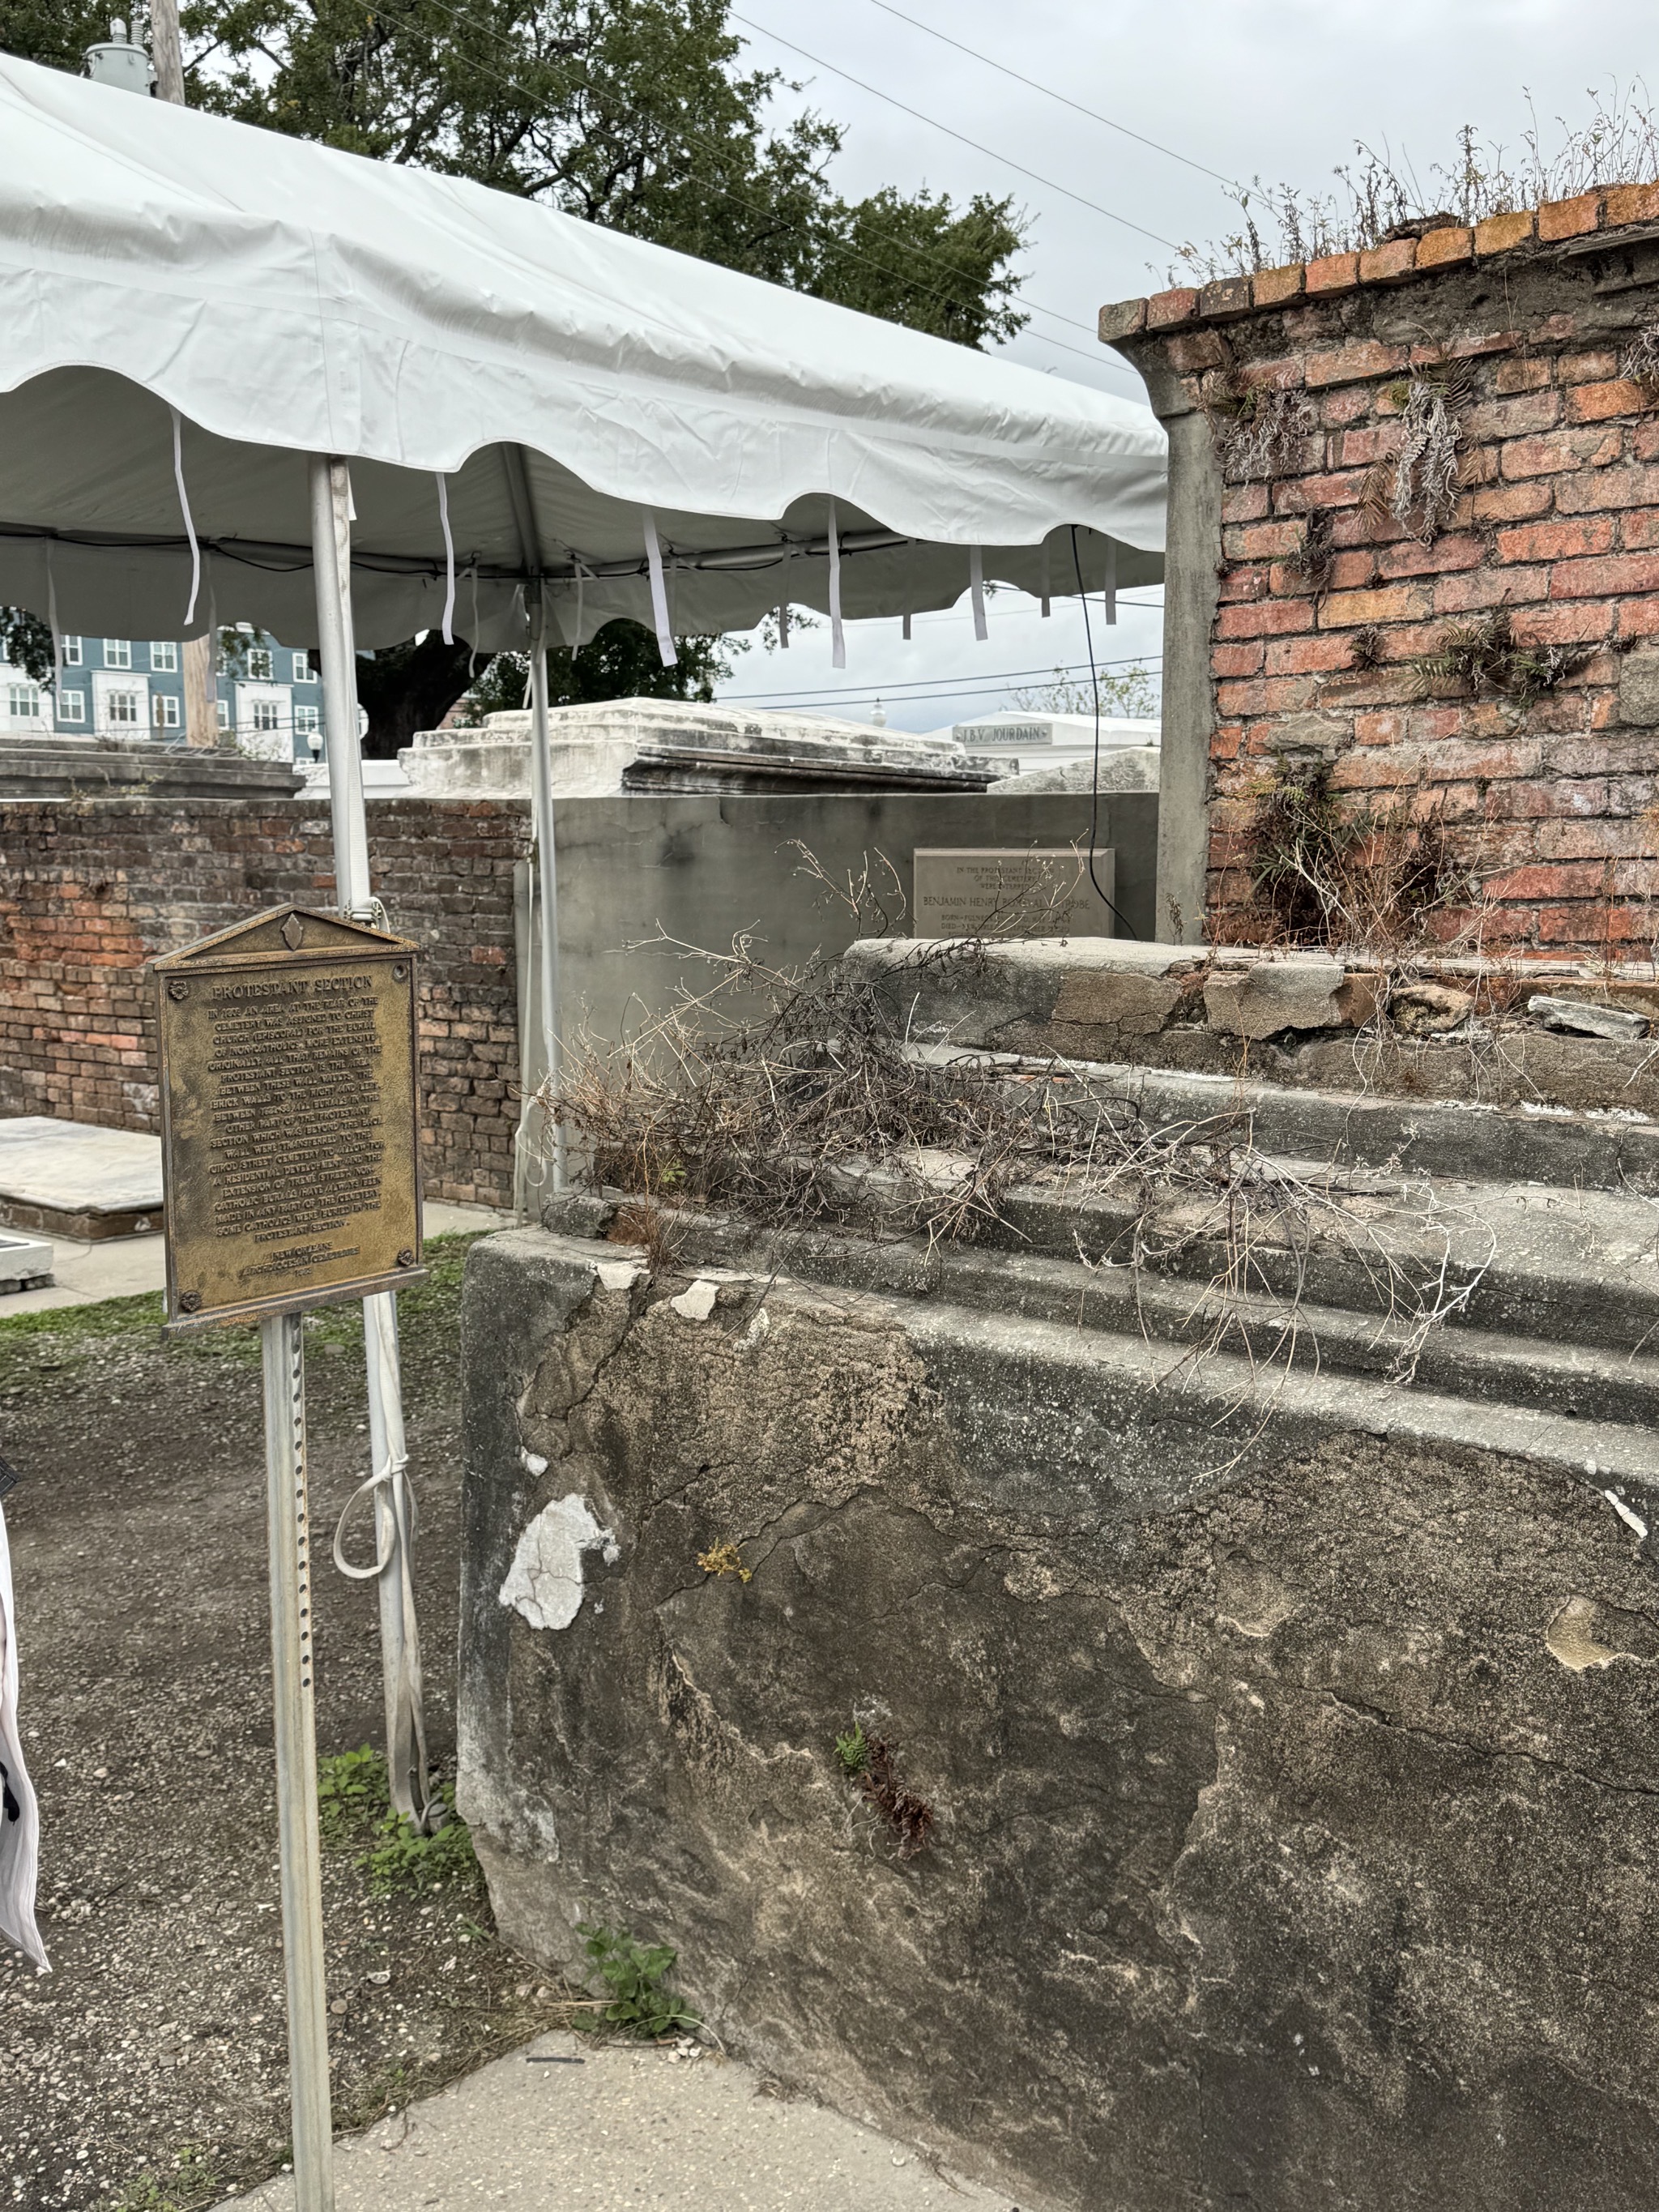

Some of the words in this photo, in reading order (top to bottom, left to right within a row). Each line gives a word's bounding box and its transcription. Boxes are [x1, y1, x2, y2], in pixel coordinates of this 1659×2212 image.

[992, 727, 1040, 741] JOURDAIN
[923, 896, 966, 906] BENJAMIN
[970, 897, 997, 907] HENRY
[1050, 899, 1090, 909] TROBE
[211, 980, 307, 1000] PROTESTANT
[314, 975, 373, 990] SECTION
[207, 1010, 217, 1018] IN
[244, 1006, 258, 1015] AN
[260, 1003, 283, 1014] AREA
[288, 1002, 300, 1011] AT
[303, 1000, 320, 1010] THE
[347, 996, 360, 1006] OF
[361, 994, 377, 1004] THE
[215, 1018, 262, 1031] CEMETERY
[264, 1016, 283, 1026] WAS
[285, 1012, 326, 1024] ASSIGNED
[328, 1010, 340, 1019] TO
[344, 1007, 373, 1018] CHRIST
[212, 1032, 249, 1044] CHURCH
[306, 1025, 324, 1035] FOR
[326, 1023, 343, 1033] THE
[345, 1019, 375, 1031] BURIAL
[215, 1048, 227, 1057] OF
[305, 1036, 328, 1047] MORE
[331, 1031, 376, 1044] EXTENSIVE
[266, 1054, 282, 1065] ALL
[286, 1051, 308, 1062] THAT
[312, 1047, 348, 1059] REMAINS
[350, 1045, 363, 1054] OF
[365, 1043, 382, 1053] THE
[219, 1083, 260, 1095] BETWEEN
[263, 1078, 290, 1090] THESE
[293, 1075, 317, 1086] WALL
[356, 1069, 373, 1078] THE
[220, 1067, 275, 1083] PROTESTANT
[279, 1063, 313, 1075] SECTION
[318, 1061, 326, 1070] IS
[328, 1059, 345, 1070] THE
[348, 1057, 369, 1067] AREA
[211, 1097, 239, 1109] BRICK
[241, 1093, 271, 1105] WALLS
[274, 1091, 287, 1101] TO
[289, 1089, 306, 1099] THE
[309, 1085, 334, 1096] RIGHT
[337, 1083, 356, 1093] AND
[213, 1108, 255, 1121] BETWEEN
[294, 1101, 309, 1110] ALL
[313, 1095, 348, 1108] BURIALS
[349, 1095, 359, 1103] IN
[361, 1091, 379, 1101] THE
[210, 1134, 249, 1147] SECTION
[252, 1129, 281, 1142] WHICH
[284, 1127, 302, 1138] WAS
[305, 1121, 339, 1134] BEYOND
[341, 1119, 358, 1129] THE
[360, 1116, 382, 1126] BACK
[225, 1121, 255, 1133] OTHER
[258, 1117, 280, 1128] PART
[282, 1116, 295, 1125] OF
[297, 1112, 315, 1122] THE
[317, 1105, 369, 1120] PROTESTANT
[209, 1161, 237, 1173] GIROD
[240, 1156, 272, 1169] STREET
[275, 1149, 318, 1164] CEMETERY
[322, 1147, 335, 1156] TO
[336, 1142, 365, 1154] ALLOW
[368, 1139, 384, 1150] FOR
[224, 1147, 250, 1158] WALL
[253, 1143, 277, 1154] WERE
[279, 1134, 337, 1150] TRANSFERRED
[339, 1132, 352, 1141] TO
[354, 1129, 372, 1139] THE
[212, 1176, 221, 1185] A
[225, 1168, 280, 1184] RESIDENTIAL
[284, 1158, 343, 1175] DEVELOPMENT
[345, 1155, 363, 1165] AND
[365, 1152, 382, 1162] THE
[214, 1196, 259, 1211] CATHOLIC
[262, 1189, 297, 1203] BURIALS
[300, 1185, 323, 1197] HAVE
[325, 1180, 360, 1193] ALWAYS
[361, 1176, 381, 1187] BEEN
[223, 1181, 270, 1196] EXTENSION
[273, 1179, 285, 1189] OF
[215, 1211, 241, 1223] MADE
[244, 1209, 254, 1219] IN
[257, 1206, 276, 1216] ANY
[278, 1202, 300, 1213] PART
[303, 1199, 315, 1208] OF
[318, 1195, 335, 1206] THE
[215, 1223, 241, 1236] SOME
[244, 1215, 291, 1231] CATHOLICS
[294, 1211, 317, 1222] WERE
[321, 1205, 349, 1217] BURIED
[352, 1202, 362, 1212] IN
[364, 1199, 381, 1210] THE
[254, 1224, 307, 1241] PROTESTANT
[271, 1248, 292, 1260] NEW
[294, 1241, 332, 1256] ORLEANS
